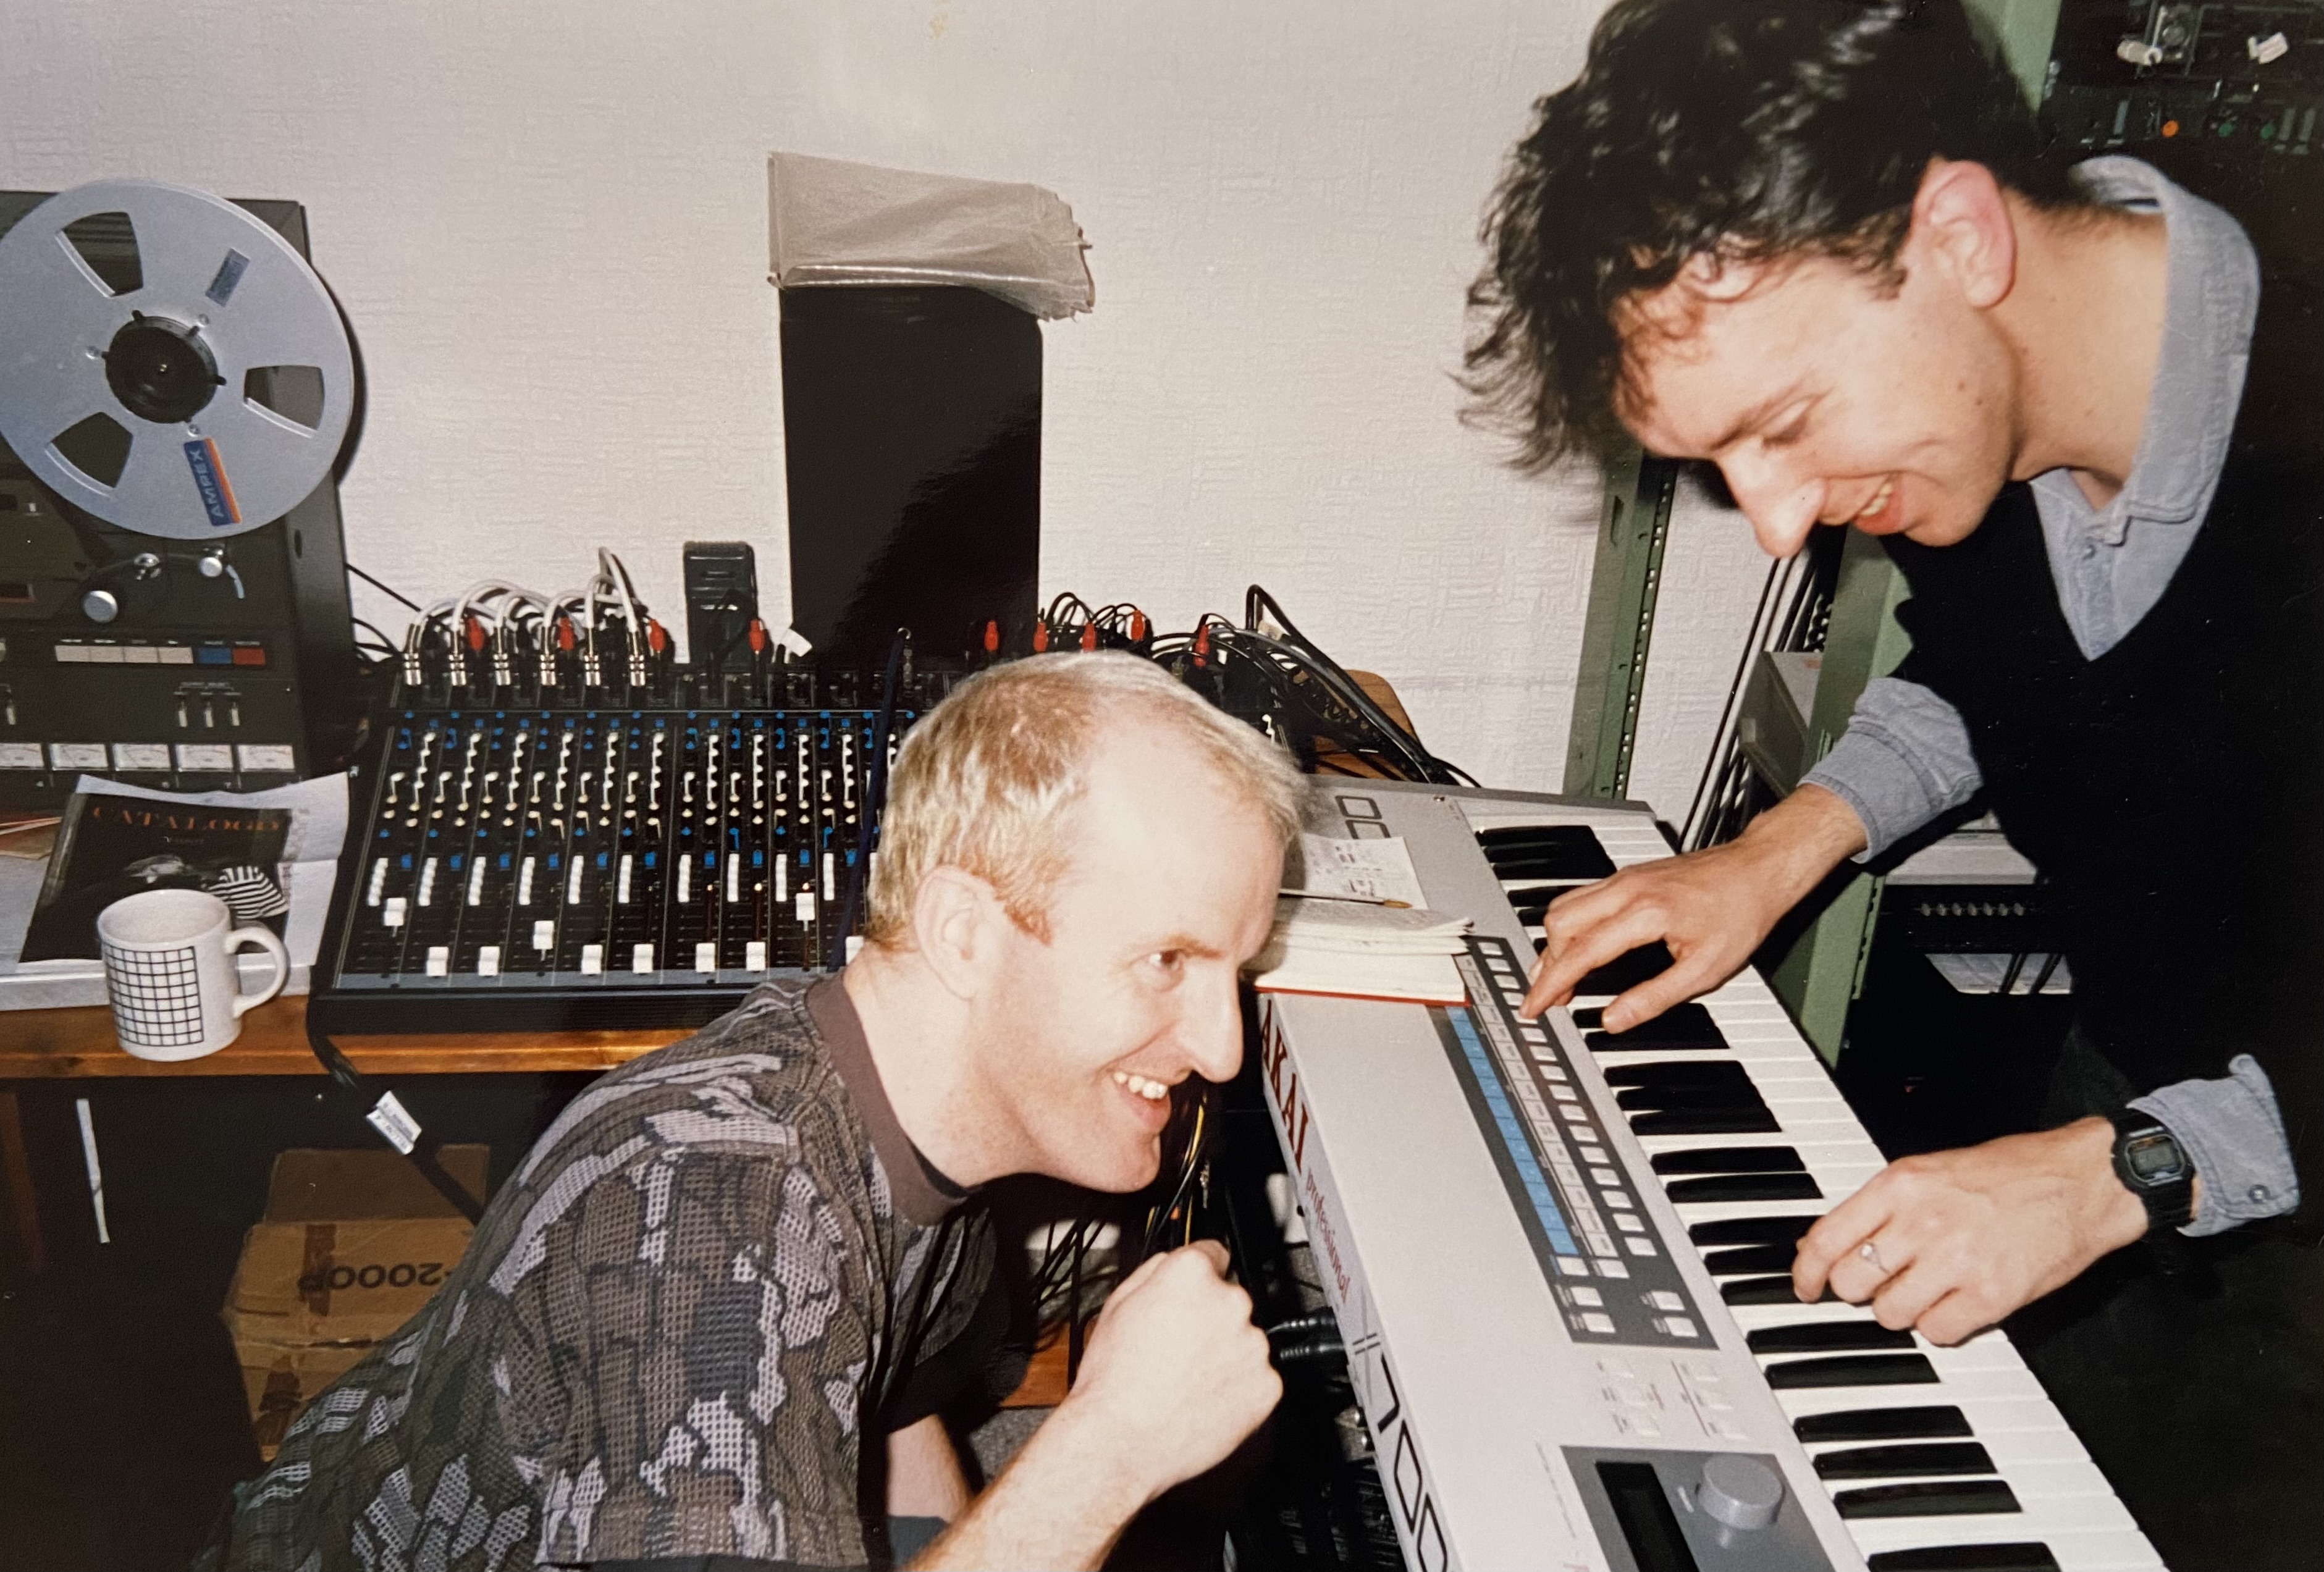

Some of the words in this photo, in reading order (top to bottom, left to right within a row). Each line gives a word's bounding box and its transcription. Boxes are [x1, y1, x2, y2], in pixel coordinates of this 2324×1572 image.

[189, 448, 224, 517] AMPEX
[1262, 998, 1309, 1175] AKAI
[1305, 1168, 1352, 1305] professional
